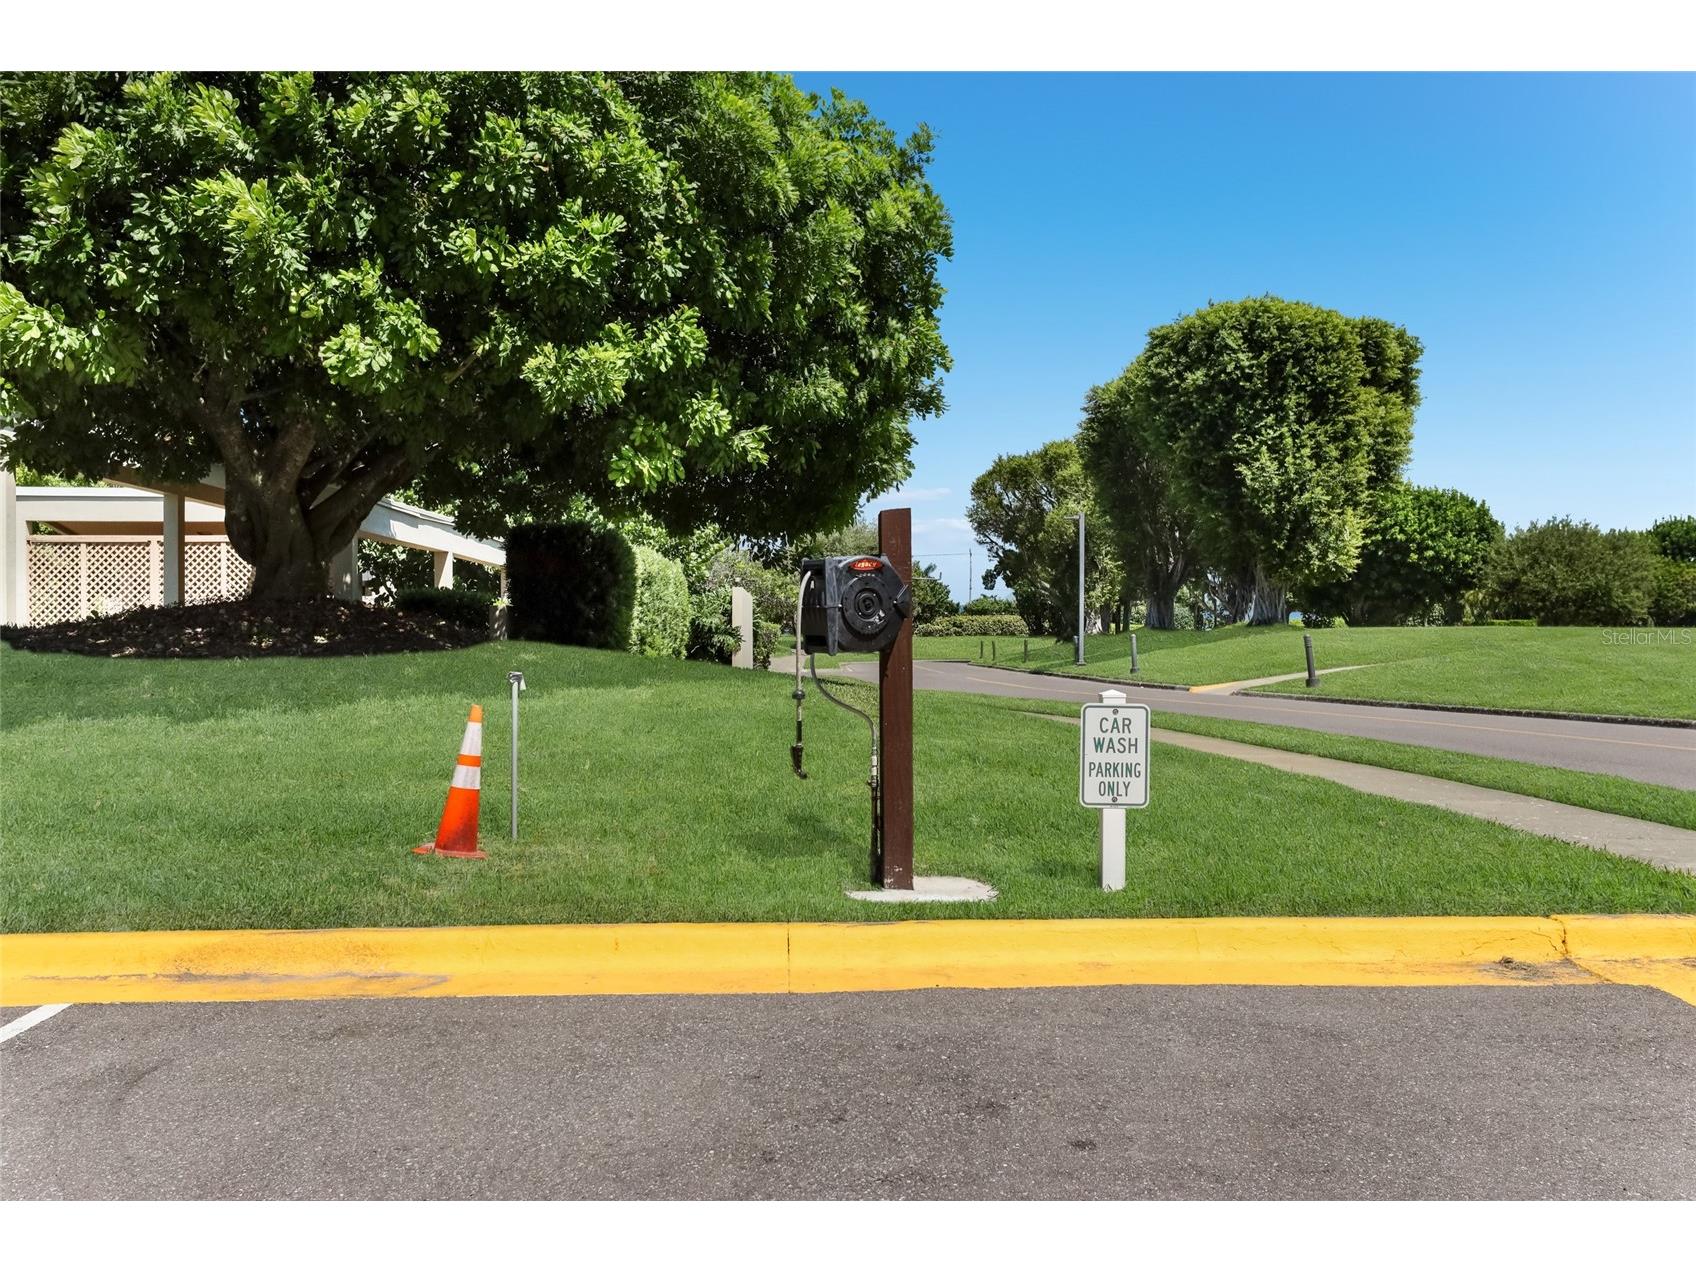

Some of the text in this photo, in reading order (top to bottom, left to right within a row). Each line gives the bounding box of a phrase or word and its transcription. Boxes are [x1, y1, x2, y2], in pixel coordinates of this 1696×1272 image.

[1100, 717, 1132, 734] CAR
[1093, 737, 1138, 754] WASH
[1088, 762, 1141, 778] PARKING
[1098, 781, 1131, 797] ONLY
